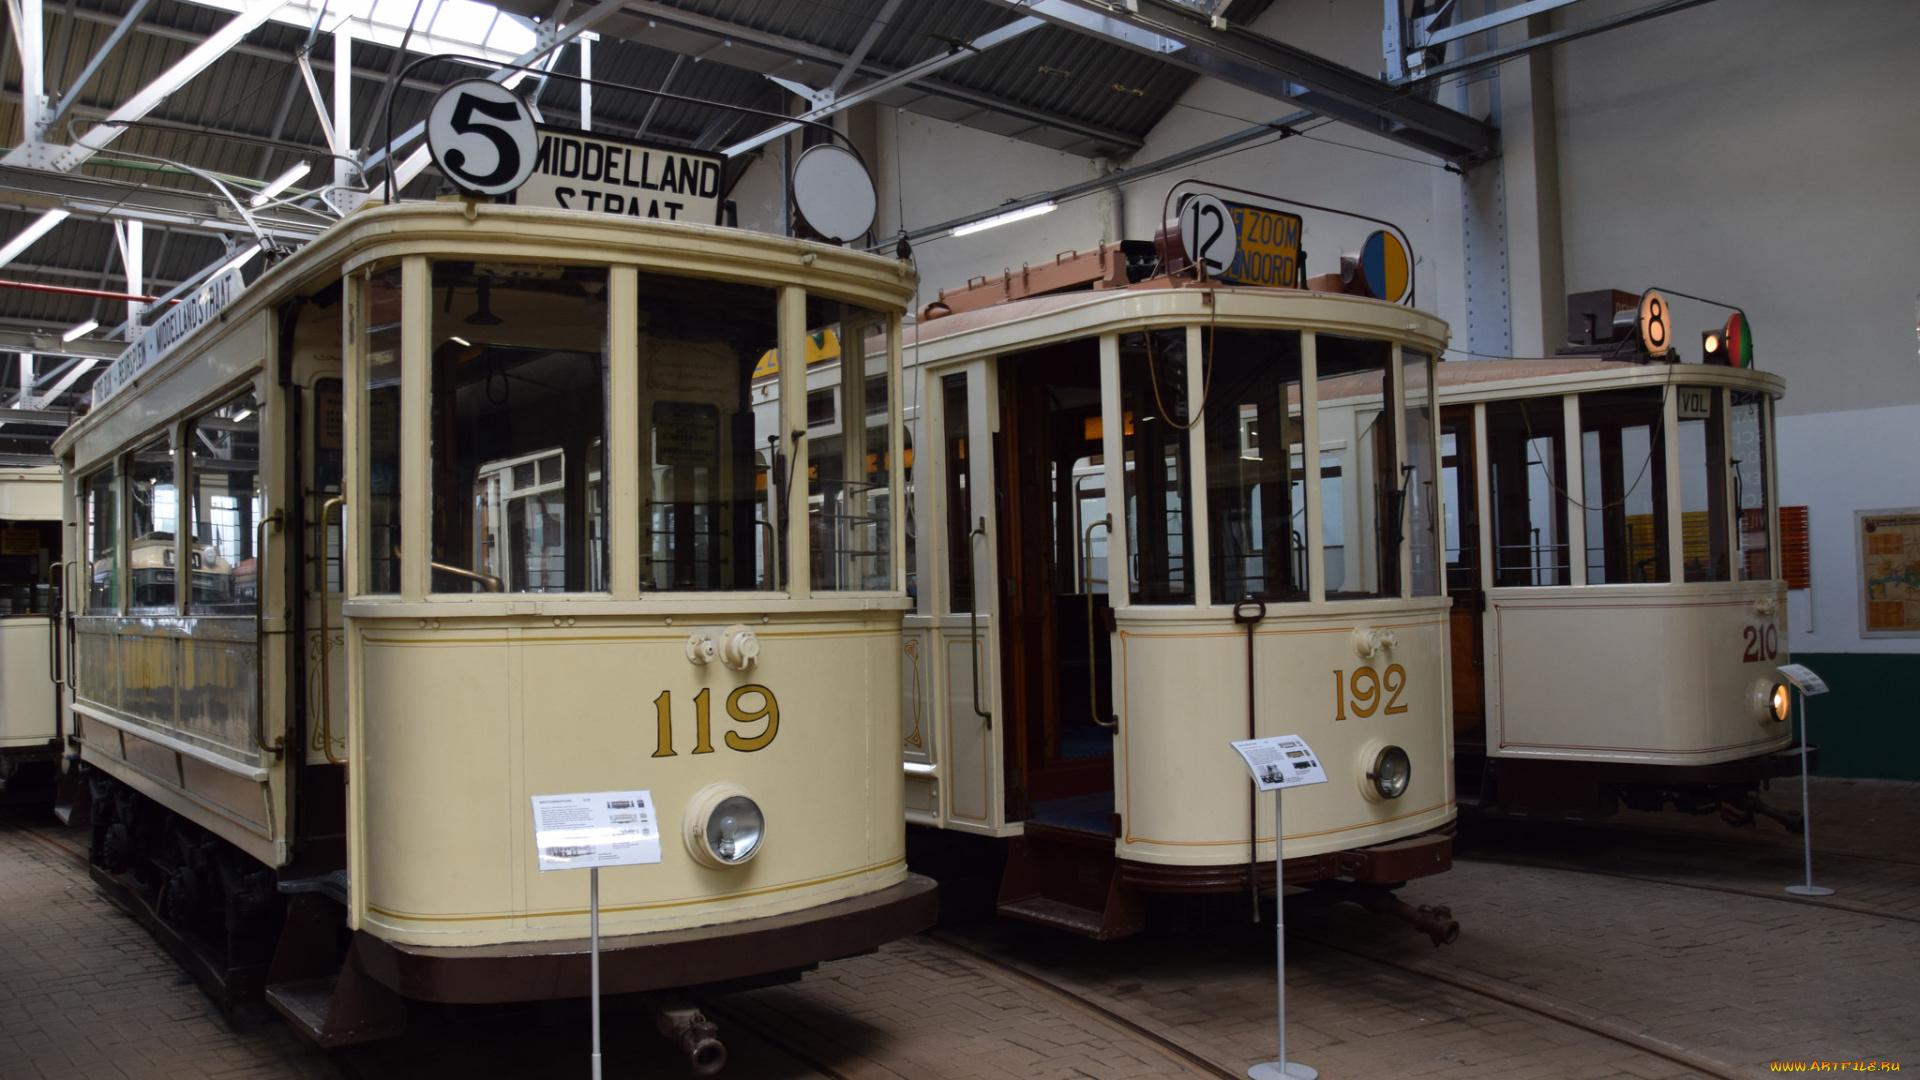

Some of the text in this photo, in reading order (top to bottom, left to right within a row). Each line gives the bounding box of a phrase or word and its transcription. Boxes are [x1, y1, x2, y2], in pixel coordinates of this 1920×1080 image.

[444, 92, 521, 187] 5
[1191, 201, 1222, 270] 12
[1247, 211, 1298, 250] ZOOM
[1649, 298, 1665, 346] 8
[1682, 394, 1708, 412] VOL
[1743, 624, 1777, 663] 210
[1333, 663, 1408, 721] 192
[651, 684, 780, 758] 119
